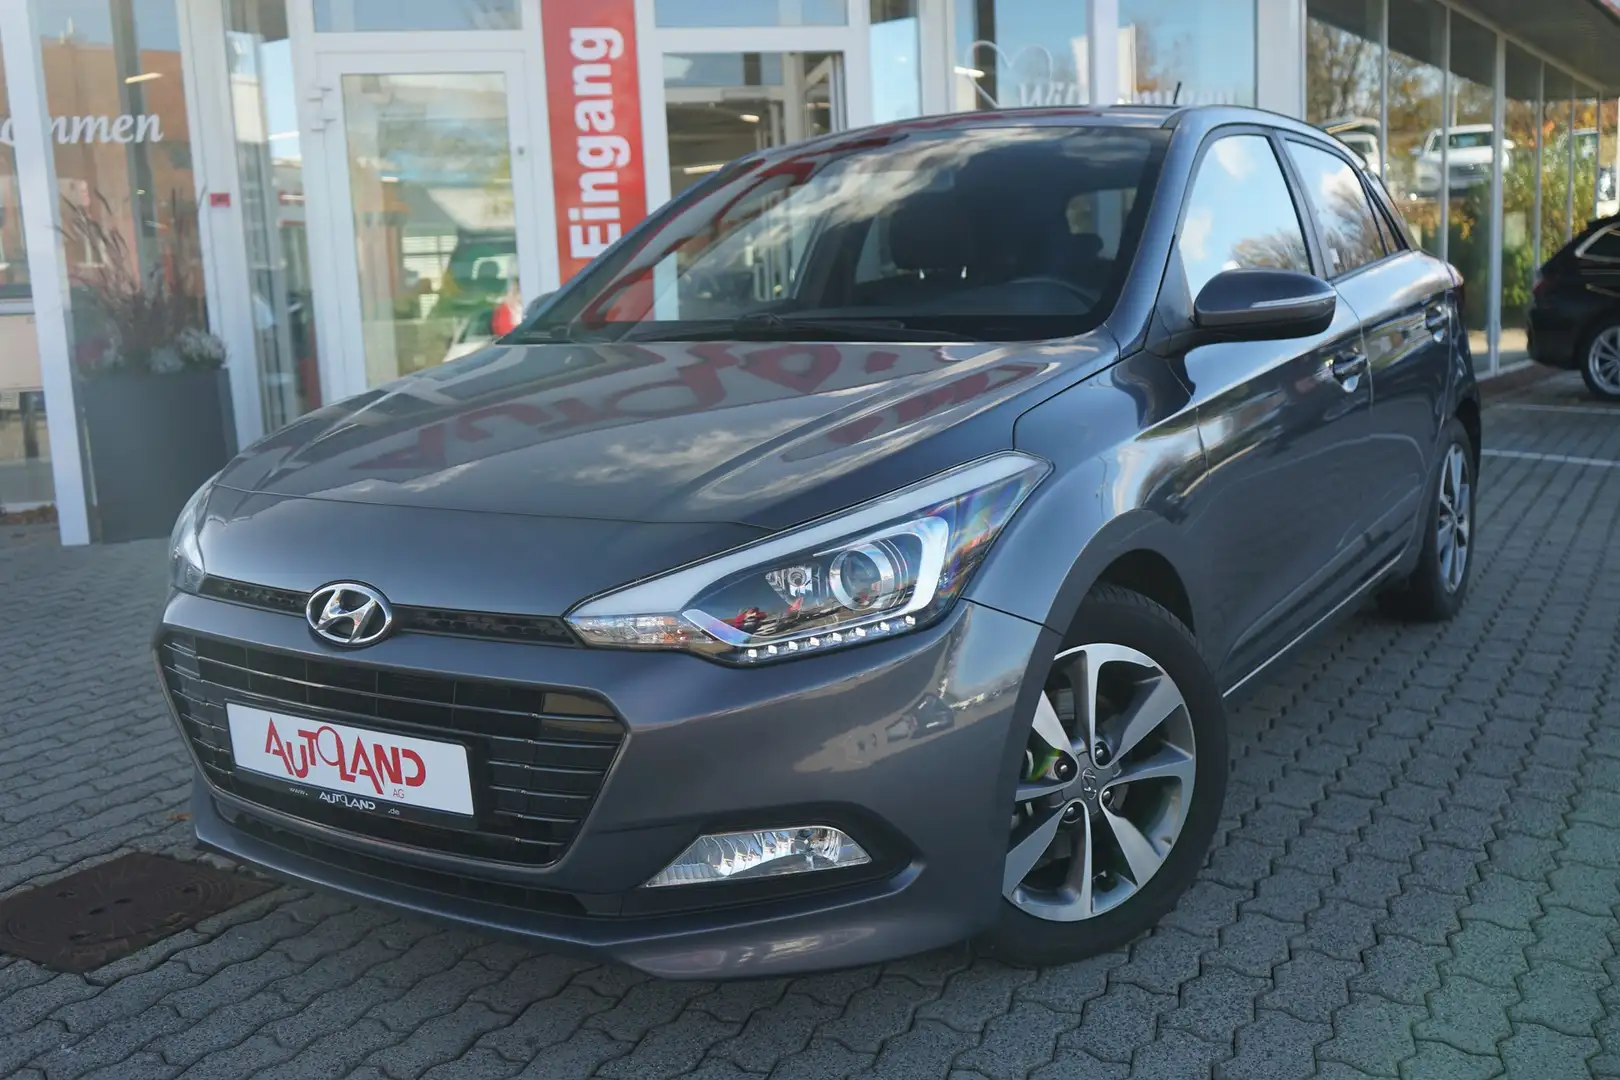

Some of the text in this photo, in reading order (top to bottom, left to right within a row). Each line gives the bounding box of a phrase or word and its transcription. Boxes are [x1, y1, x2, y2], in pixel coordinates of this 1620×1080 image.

[568, 27, 631, 258] Eingang
[264, 717, 426, 795] AUTOLAND
[319, 791, 376, 810] AUTOLAND
[392, 788, 405, 799] AG
